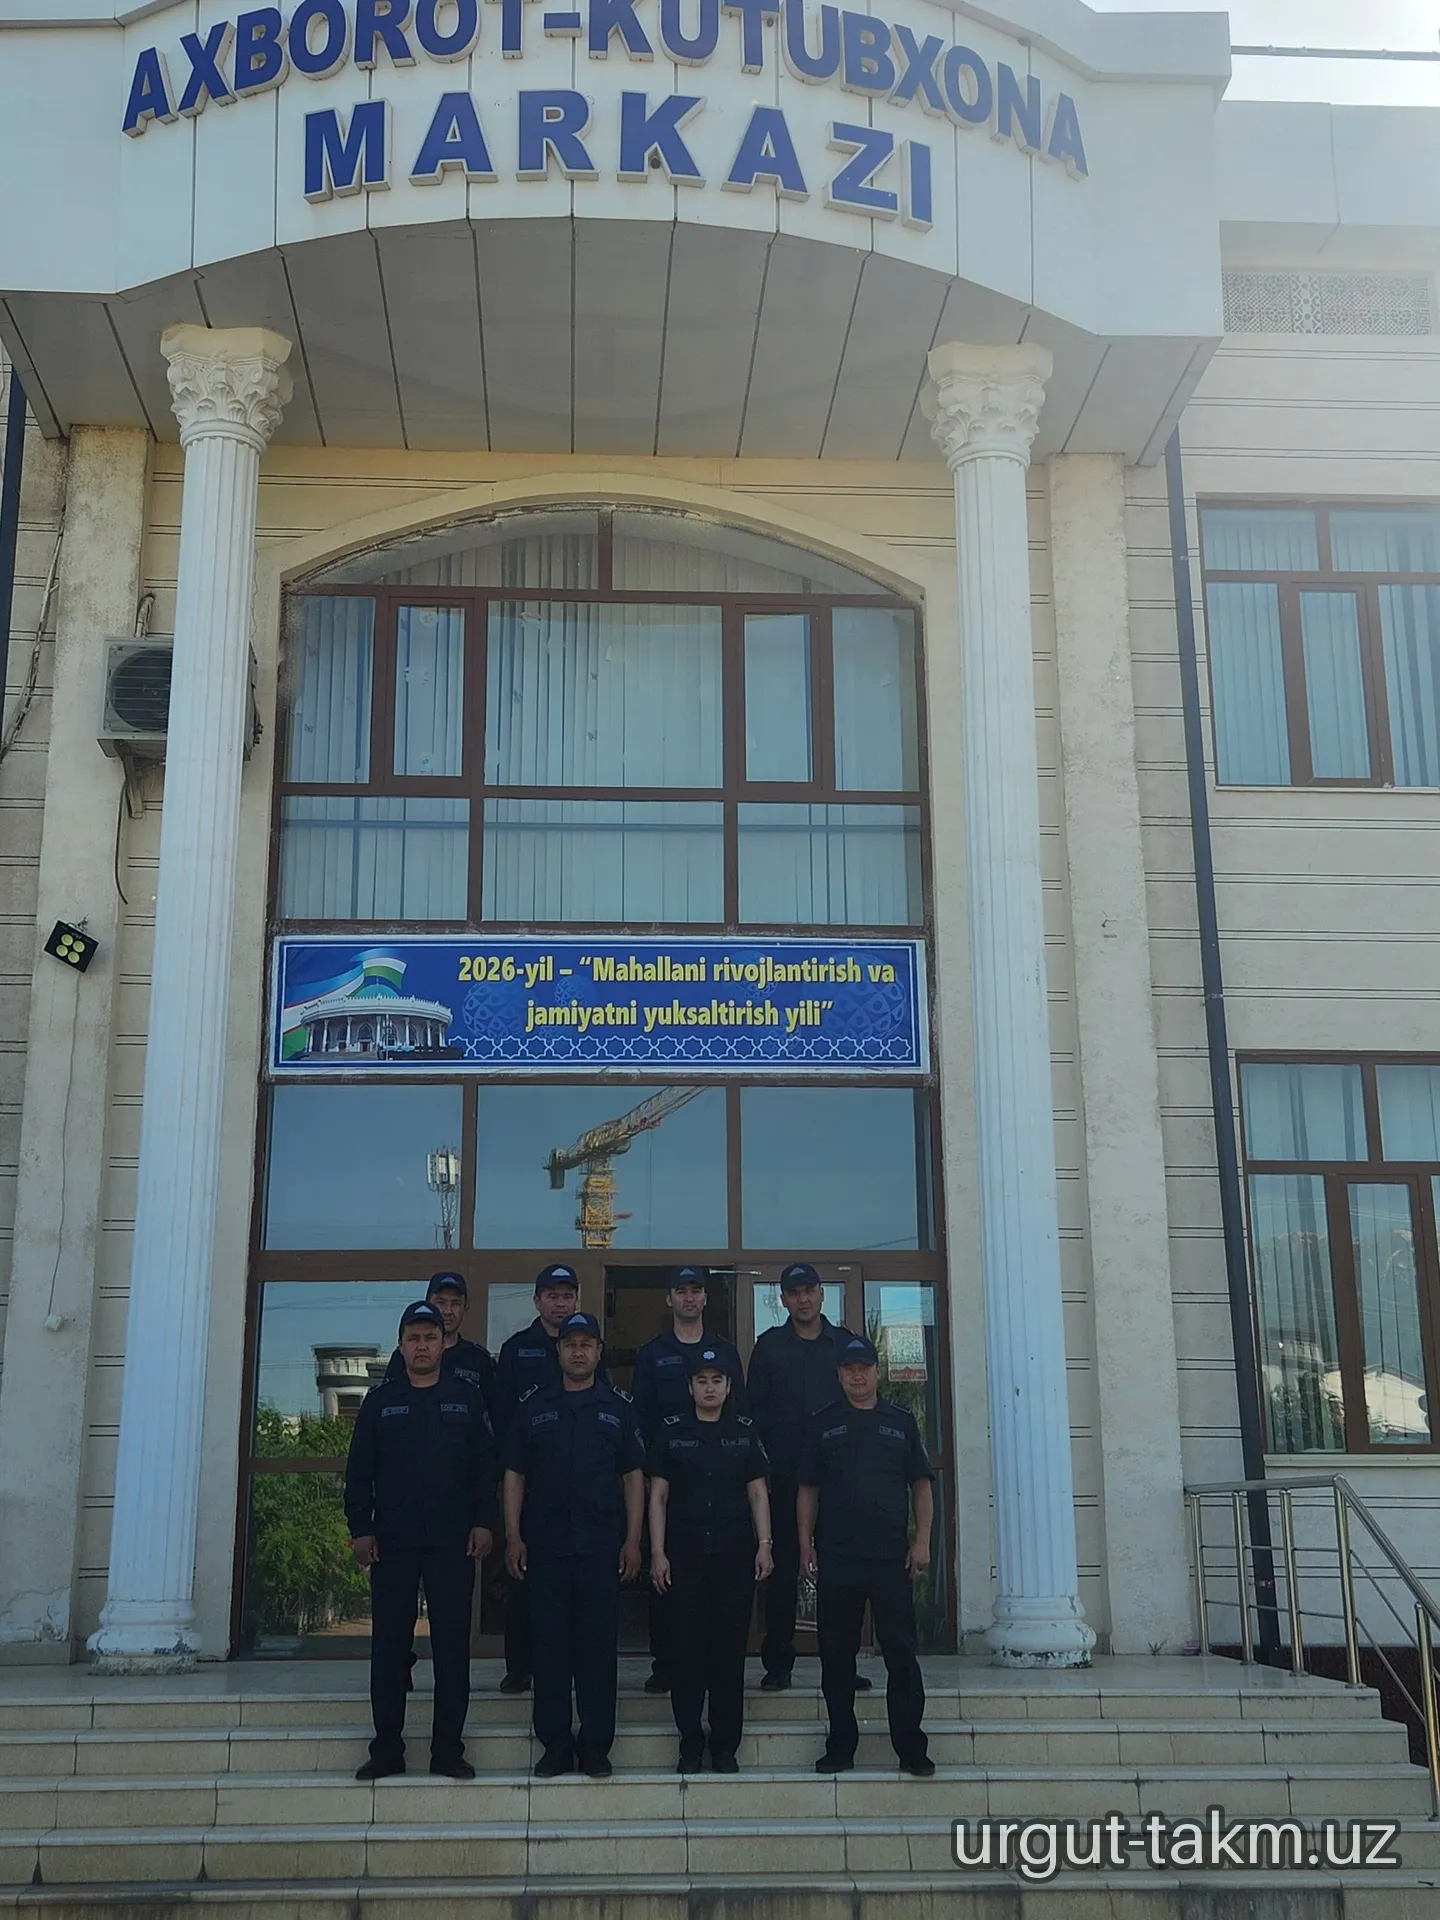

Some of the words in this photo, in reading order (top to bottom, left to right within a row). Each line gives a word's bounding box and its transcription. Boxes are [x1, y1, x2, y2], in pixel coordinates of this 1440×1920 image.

[303, 89, 933, 231] MARKAZI
[458, 956, 553, 988] 2026-yil
[579, 956, 706, 982] “Mahallani
[713, 956, 862, 989] rivojlantirish
[867, 964, 895, 983] va
[525, 1000, 637, 1032] jamiyatni
[643, 1000, 779, 1032] yuksaltirish
[785, 1001, 834, 1033] yili”
